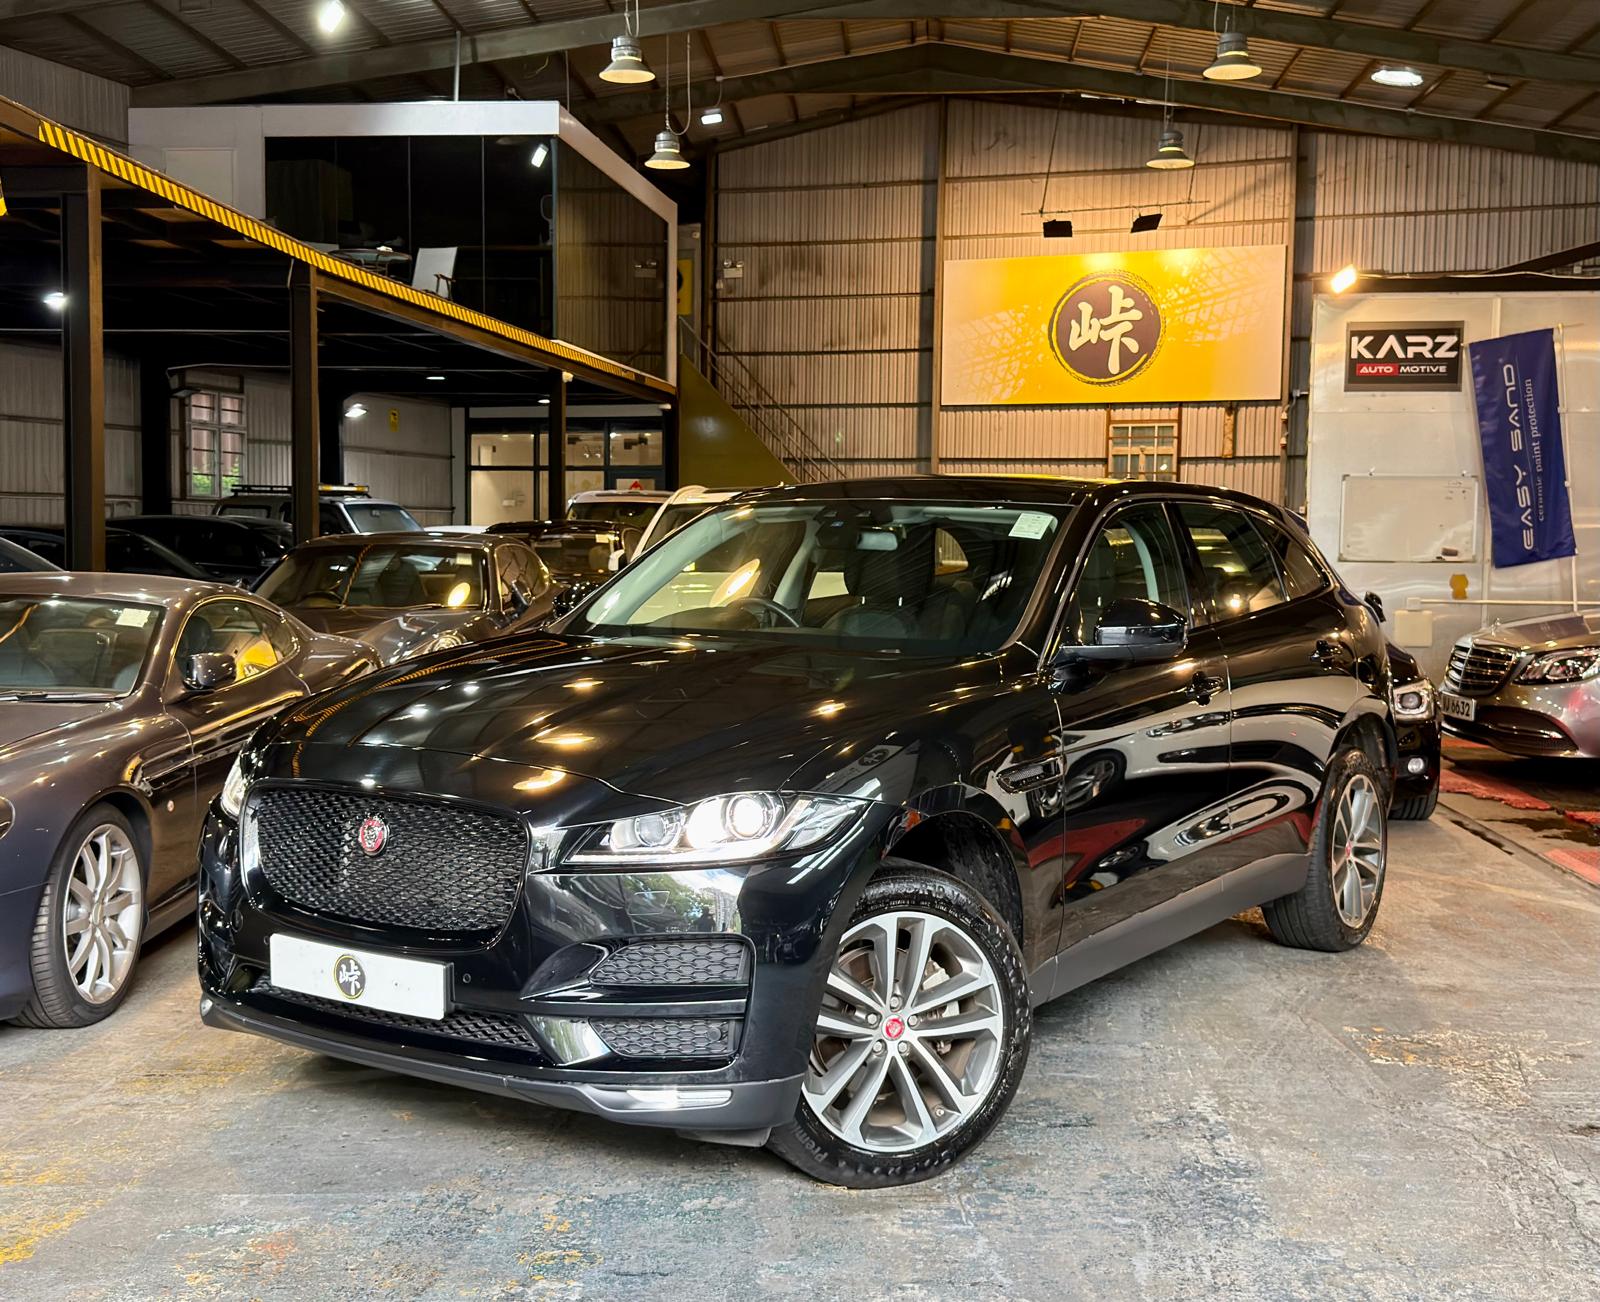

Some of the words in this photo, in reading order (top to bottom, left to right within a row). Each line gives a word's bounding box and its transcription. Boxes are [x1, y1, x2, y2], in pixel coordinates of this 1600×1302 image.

[1069, 285, 1143, 375] 峠
[1350, 334, 1459, 359] KARZ
[1359, 365, 1394, 374] AUTO
[1399, 365, 1447, 374] MOTIVE
[1503, 364, 1522, 452] SAND
[1524, 378, 1541, 438] protection
[1532, 440, 1543, 472] paint
[1513, 464, 1534, 550] EASY
[1536, 475, 1544, 522] ceramic
[1451, 700, 1470, 717] 6632
[339, 959, 361, 996] 峠
